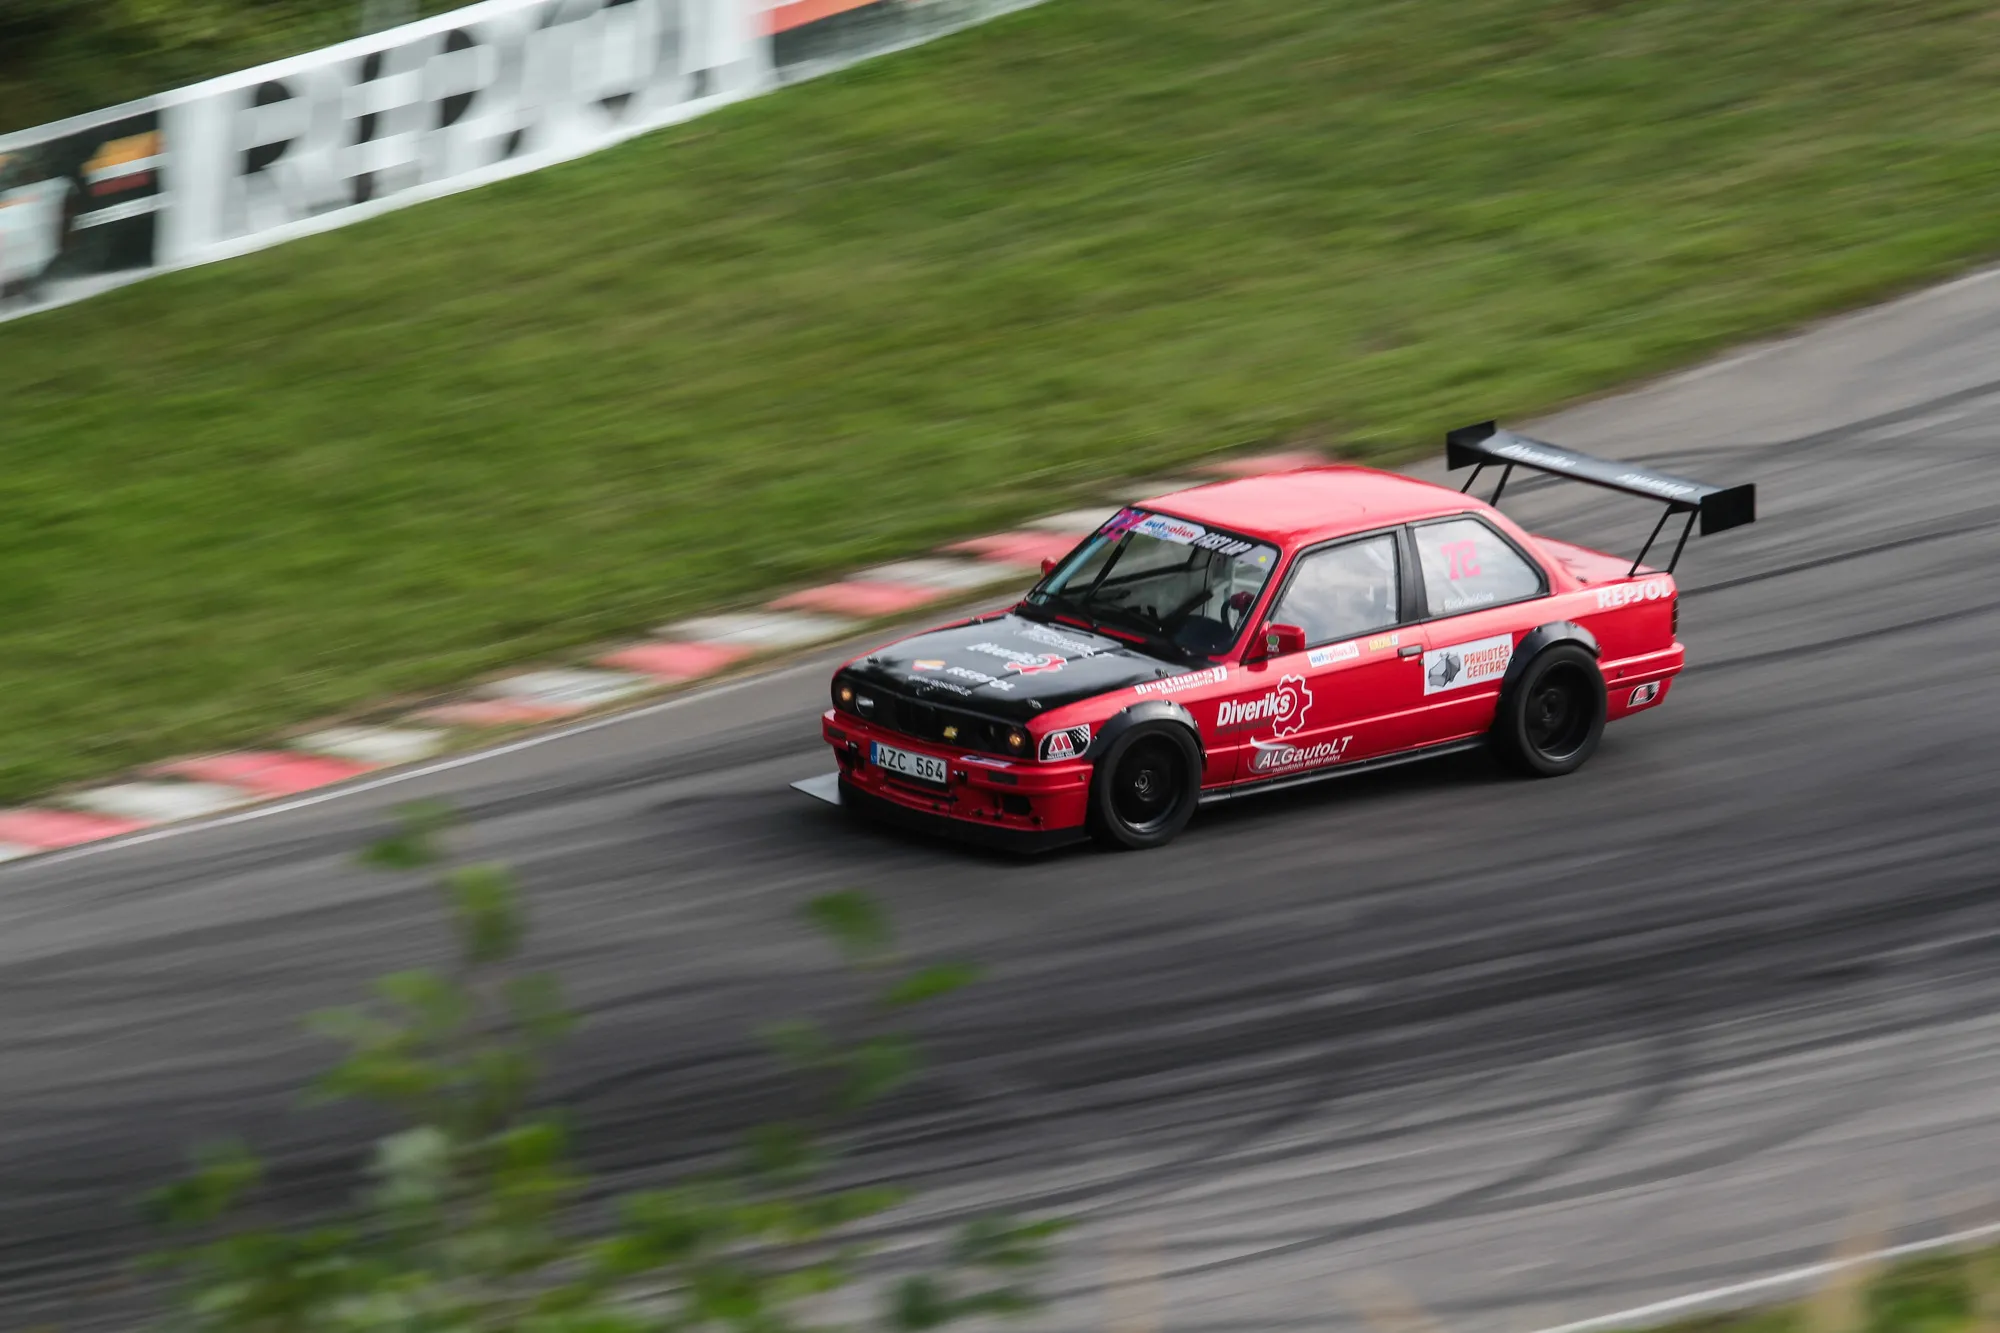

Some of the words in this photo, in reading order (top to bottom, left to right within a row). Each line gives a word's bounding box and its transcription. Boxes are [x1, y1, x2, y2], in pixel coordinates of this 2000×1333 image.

[1441, 539, 1481, 581] 72
[1597, 578, 1671, 609] REPSOL
[1467, 659, 1507, 679] CENTRAS
[1216, 691, 1291, 727] Diveriks
[878, 746, 907, 771] AZC
[916, 757, 944, 781] 564
[1258, 735, 1354, 769] ALGautoLT
